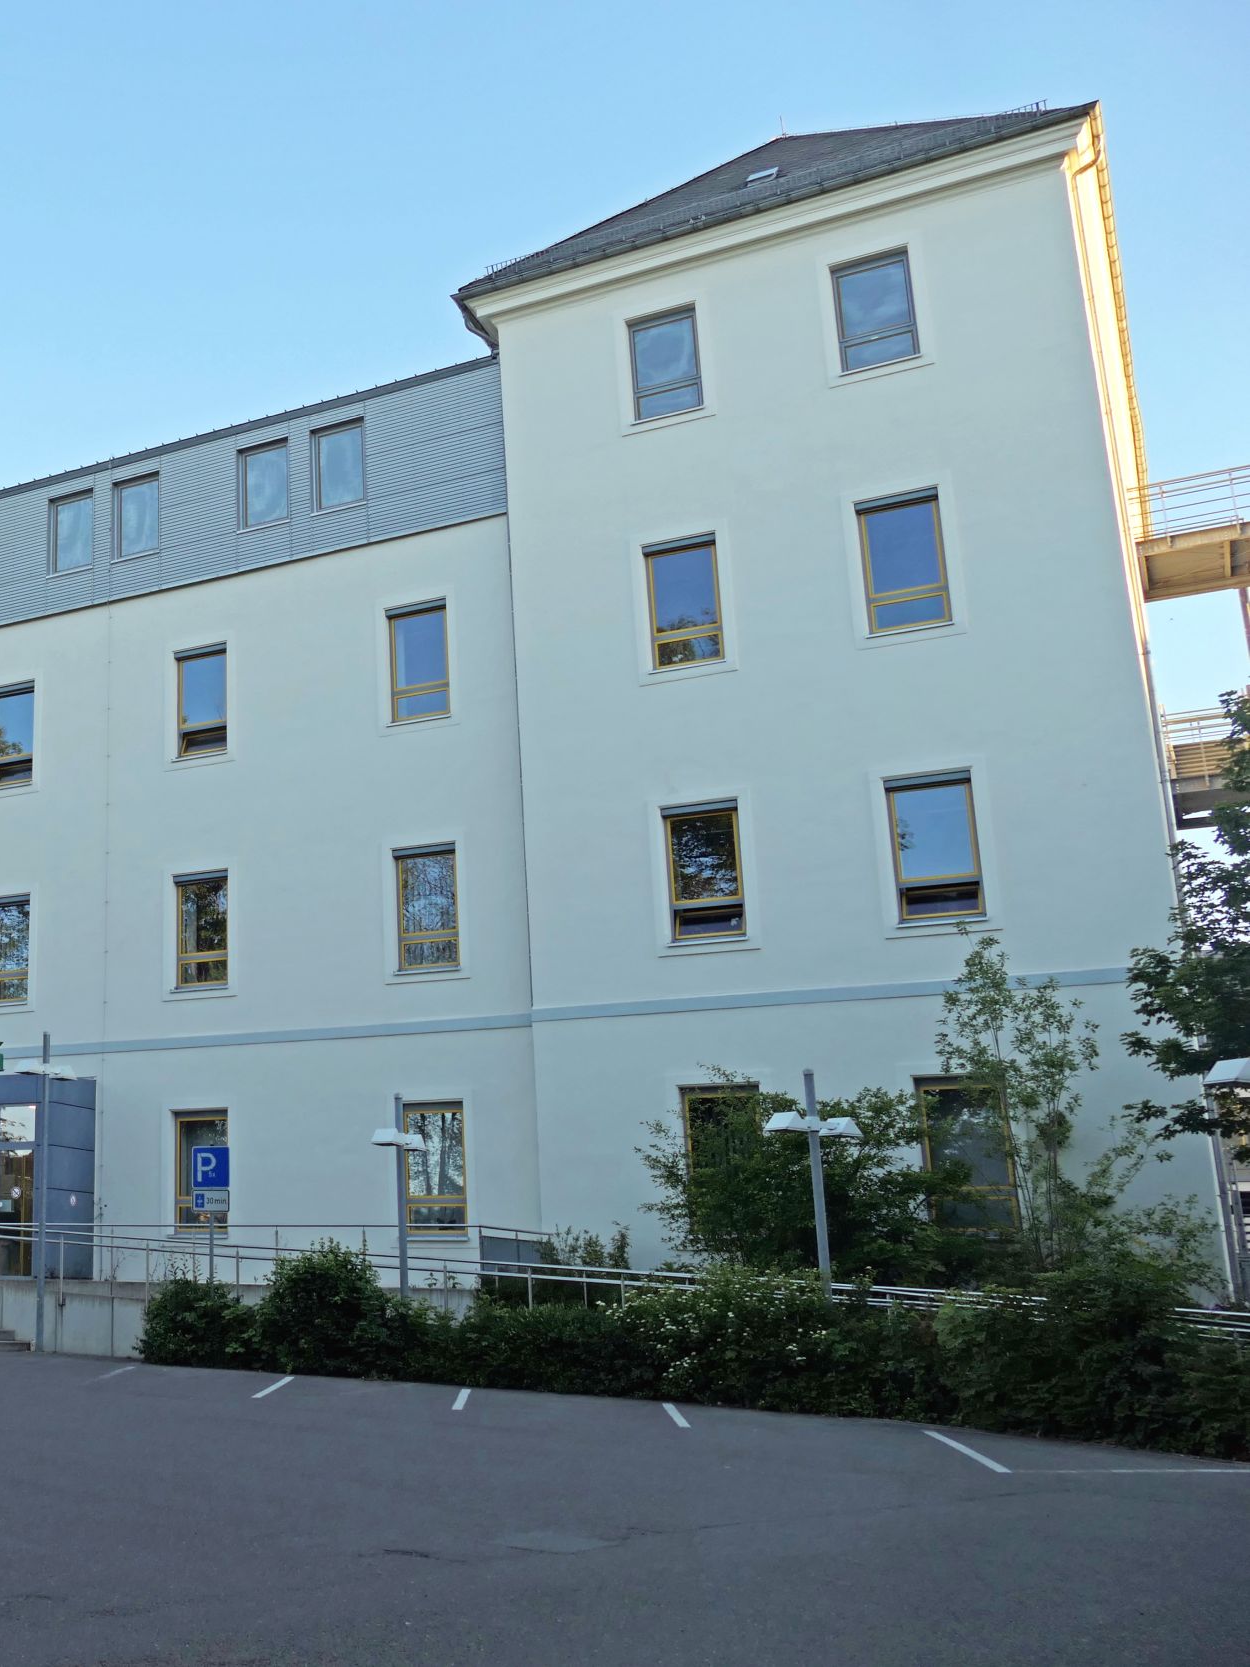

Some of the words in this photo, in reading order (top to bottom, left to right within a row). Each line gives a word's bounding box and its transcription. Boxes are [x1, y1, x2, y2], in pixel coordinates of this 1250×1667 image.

[197, 1152, 216, 1182] P
[206, 1197, 214, 1205] 30
[214, 1197, 227, 1205] min
